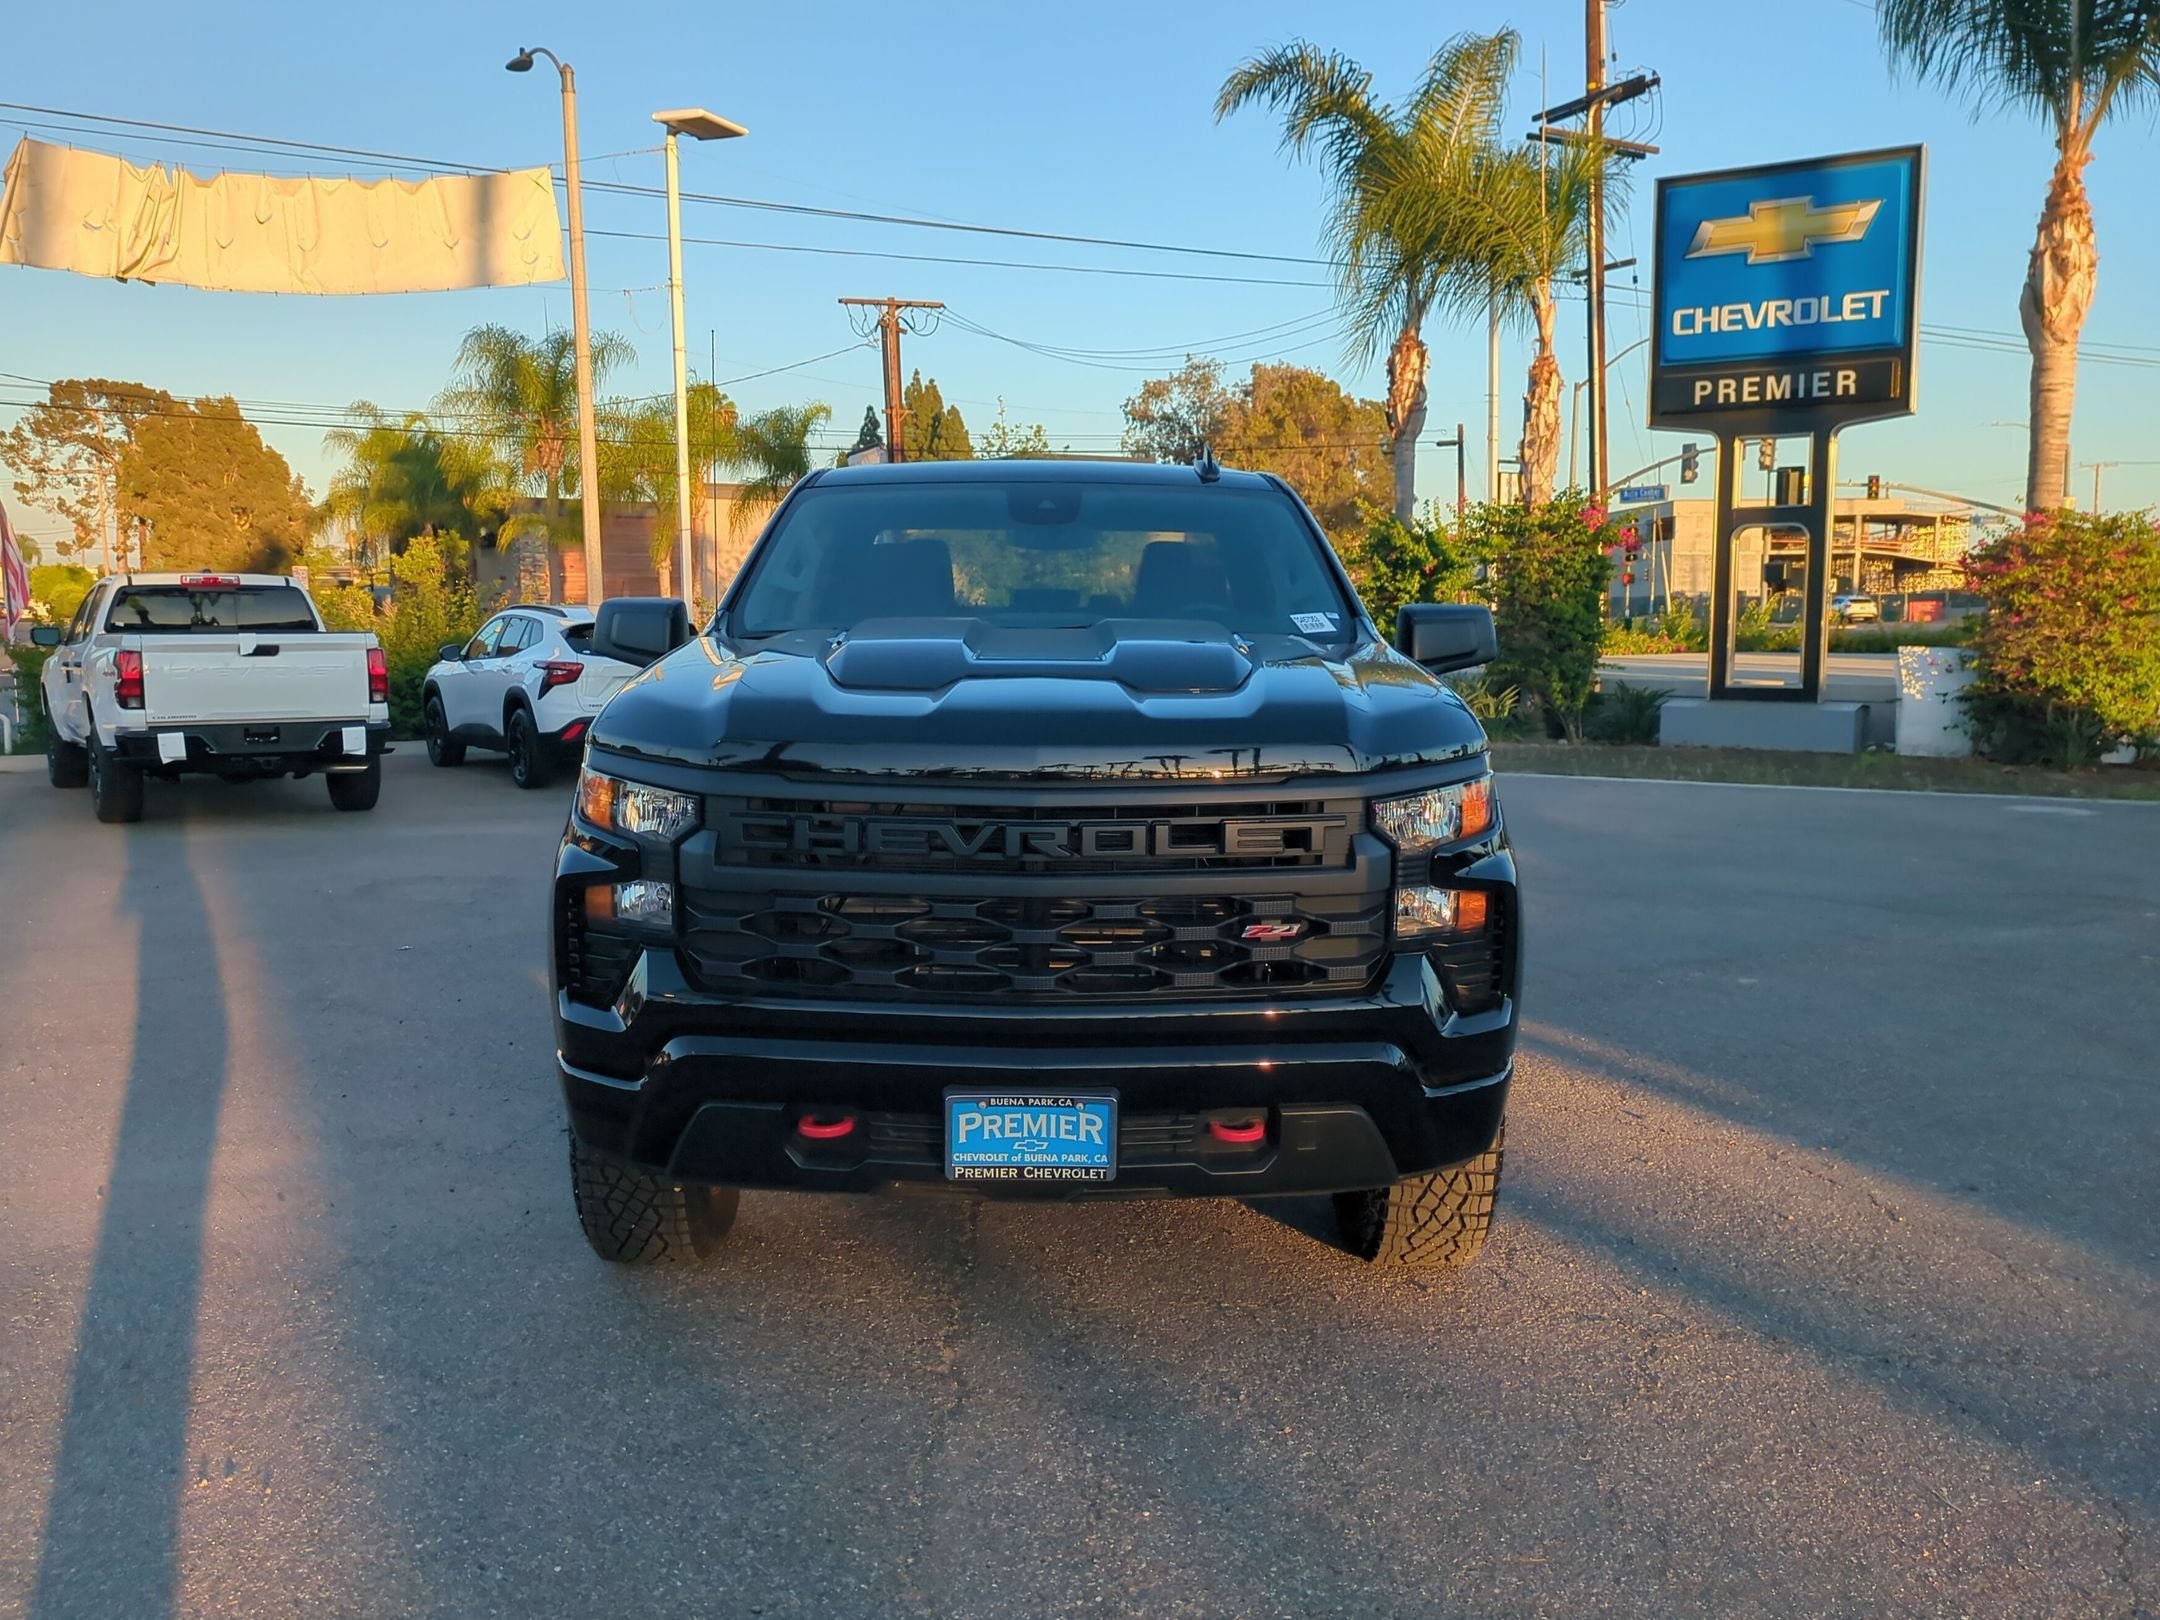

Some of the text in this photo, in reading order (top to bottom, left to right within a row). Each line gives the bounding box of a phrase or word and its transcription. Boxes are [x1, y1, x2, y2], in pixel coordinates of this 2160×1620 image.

[1672, 289, 1890, 336] CHEVROLET
[1694, 370, 1857, 406] PREMIER
[729, 814, 1347, 858] CHEVROLET
[990, 1098, 1025, 1106] BUENA
[957, 1112, 1104, 1145] PREMIER
[953, 1153, 1108, 1164] CHEVROLET of BUENA PARK, CA
[954, 1166, 1107, 1179] PREMIER CHEVROLET
